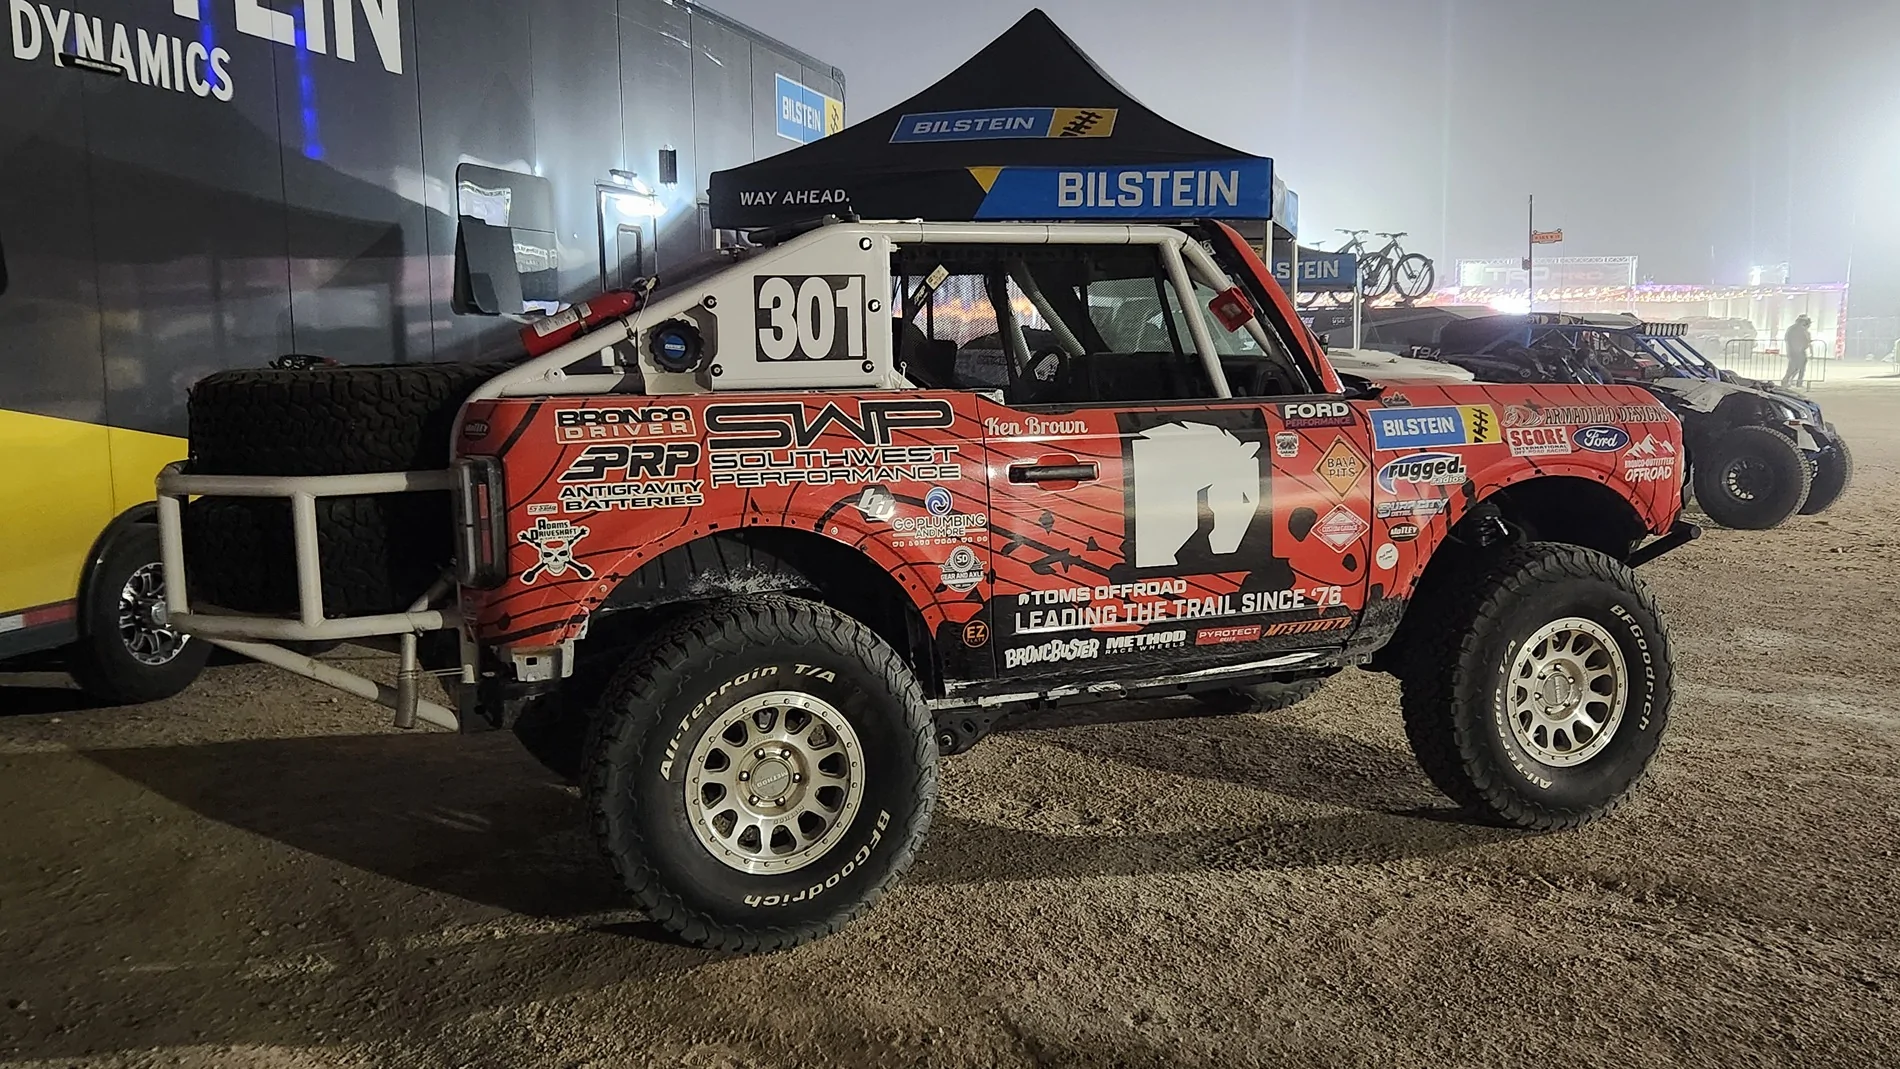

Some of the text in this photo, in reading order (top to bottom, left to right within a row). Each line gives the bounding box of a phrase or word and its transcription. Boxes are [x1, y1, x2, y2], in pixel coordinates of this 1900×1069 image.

[10, 0, 234, 102] DYNAMICS
[781, 94, 822, 133] BILSTEIN
[912, 116, 1035, 135] BILSTEIN
[740, 189, 851, 206] WAY AHEAD.
[1058, 170, 1240, 208] BILSTEIN
[758, 276, 864, 360] 301
[557, 407, 691, 427] BRONCO
[1284, 402, 1350, 419] FORD
[1544, 405, 1670, 425] ARMADILLO DESIGNS
[565, 423, 688, 439] DRIVER
[705, 399, 954, 450] SWP
[985, 416, 1088, 436] Ken Brown
[1285, 416, 1352, 428] PERFORMANCE
[1382, 416, 1456, 438] BILSTEIN
[1510, 428, 1567, 447] SCORE
[1584, 430, 1618, 447] Ford
[558, 443, 701, 482] PRP
[710, 445, 958, 470] SOUTHWEST
[711, 465, 961, 489] PERFORMANCE
[1329, 468, 1356, 478] PITS
[1431, 474, 1467, 485] radios
[1624, 466, 1673, 483] OFFROAD
[559, 481, 703, 499] ANTIGRAVITY
[564, 494, 704, 512] BATTERIES
[537, 519, 569, 530] ADAMS
[916, 513, 987, 529] PLUMBING
[530, 528, 577, 540] DRIVESHAFT
[915, 528, 965, 538] AND MORE
[956, 554, 968, 564] SD
[969, 569, 984, 578] AXLE
[1030, 580, 1187, 605] TOMS OFFROAD
[1015, 605, 1117, 631] LEADING
[1123, 601, 1169, 624] THE
[1175, 595, 1236, 619] TRAIL
[1242, 589, 1305, 613] SINCE
[966, 625, 985, 639] EZ
[1106, 630, 1187, 650] METHOD
[1199, 627, 1259, 638] PYROTECT
[1105, 641, 1185, 655] RACE WHEELS
[1609, 604, 1656, 731] BFGoodrich
[660, 663, 837, 781] All-Terrain T/A
[744, 809, 891, 908] BFGoodrich
